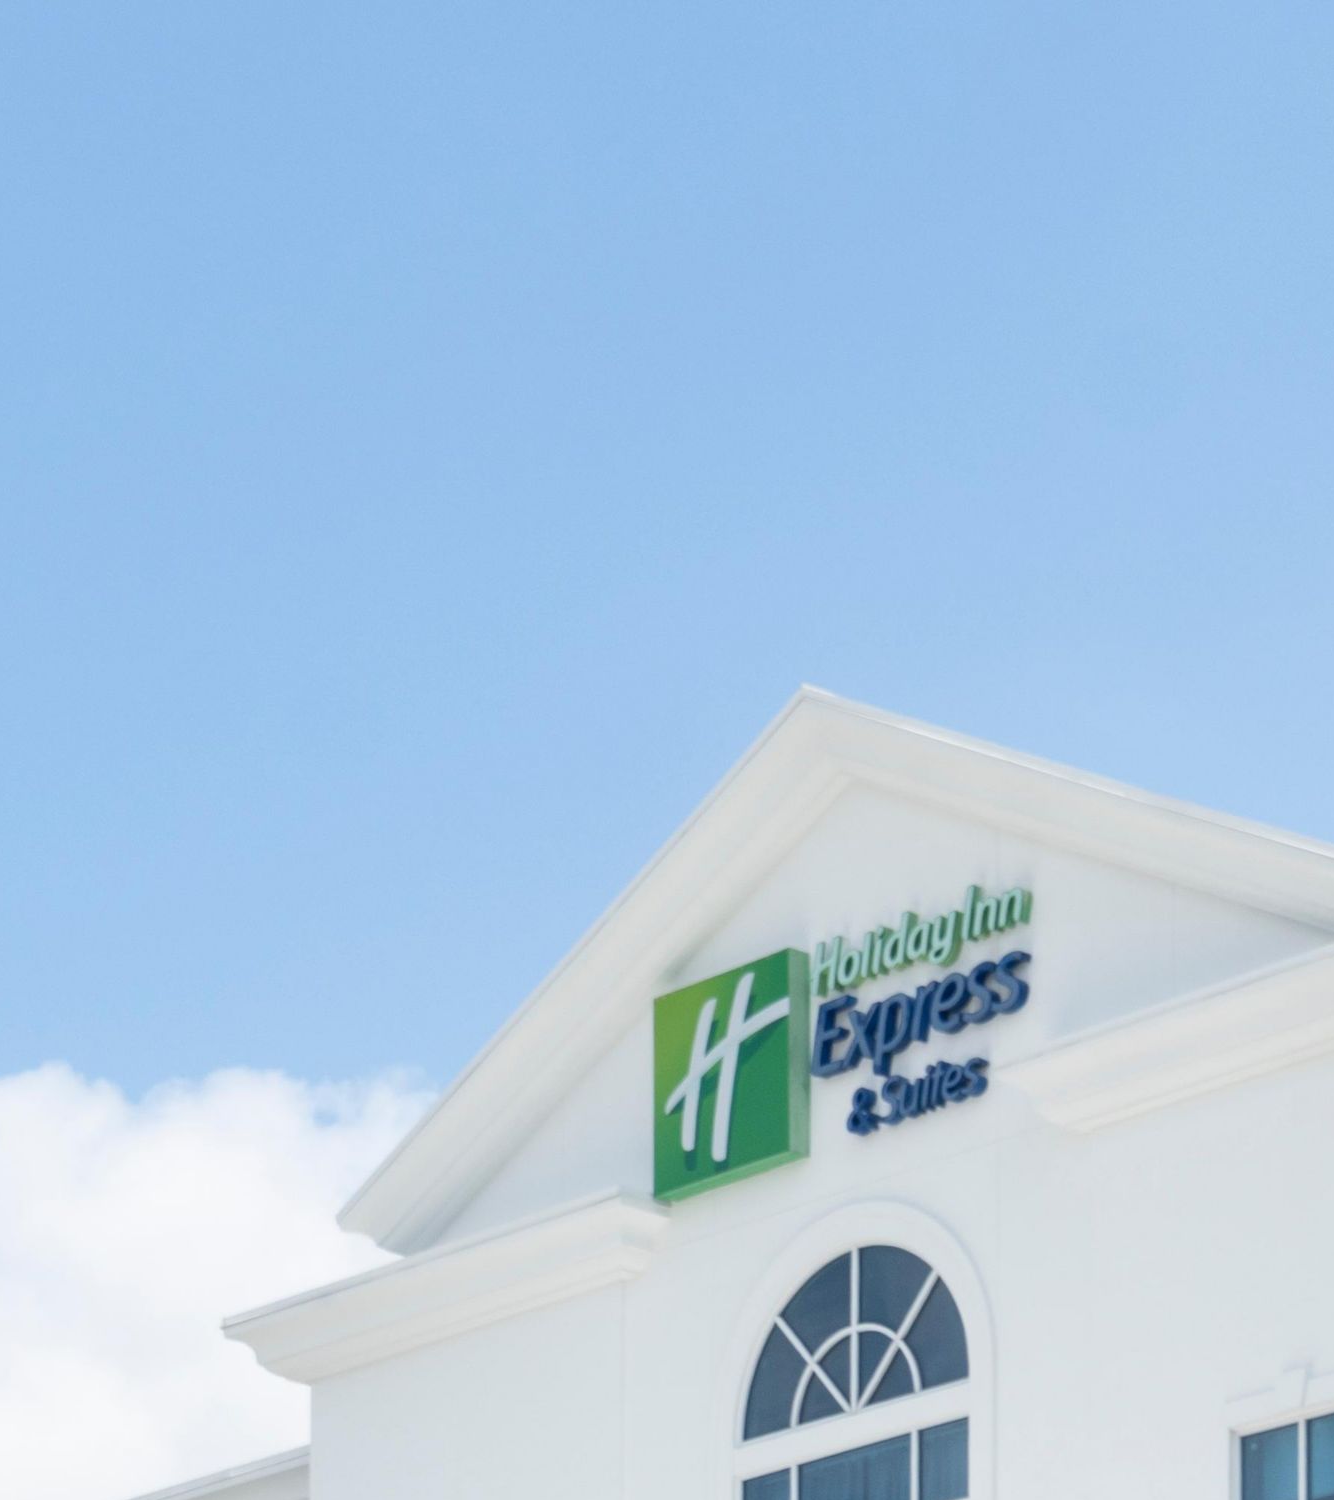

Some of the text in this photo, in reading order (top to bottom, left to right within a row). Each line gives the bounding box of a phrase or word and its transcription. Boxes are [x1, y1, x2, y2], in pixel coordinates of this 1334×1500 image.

[810, 884, 1033, 997] Holiday Inn
[810, 950, 1032, 1079] Express
[846, 1057, 990, 1136] & Suites
